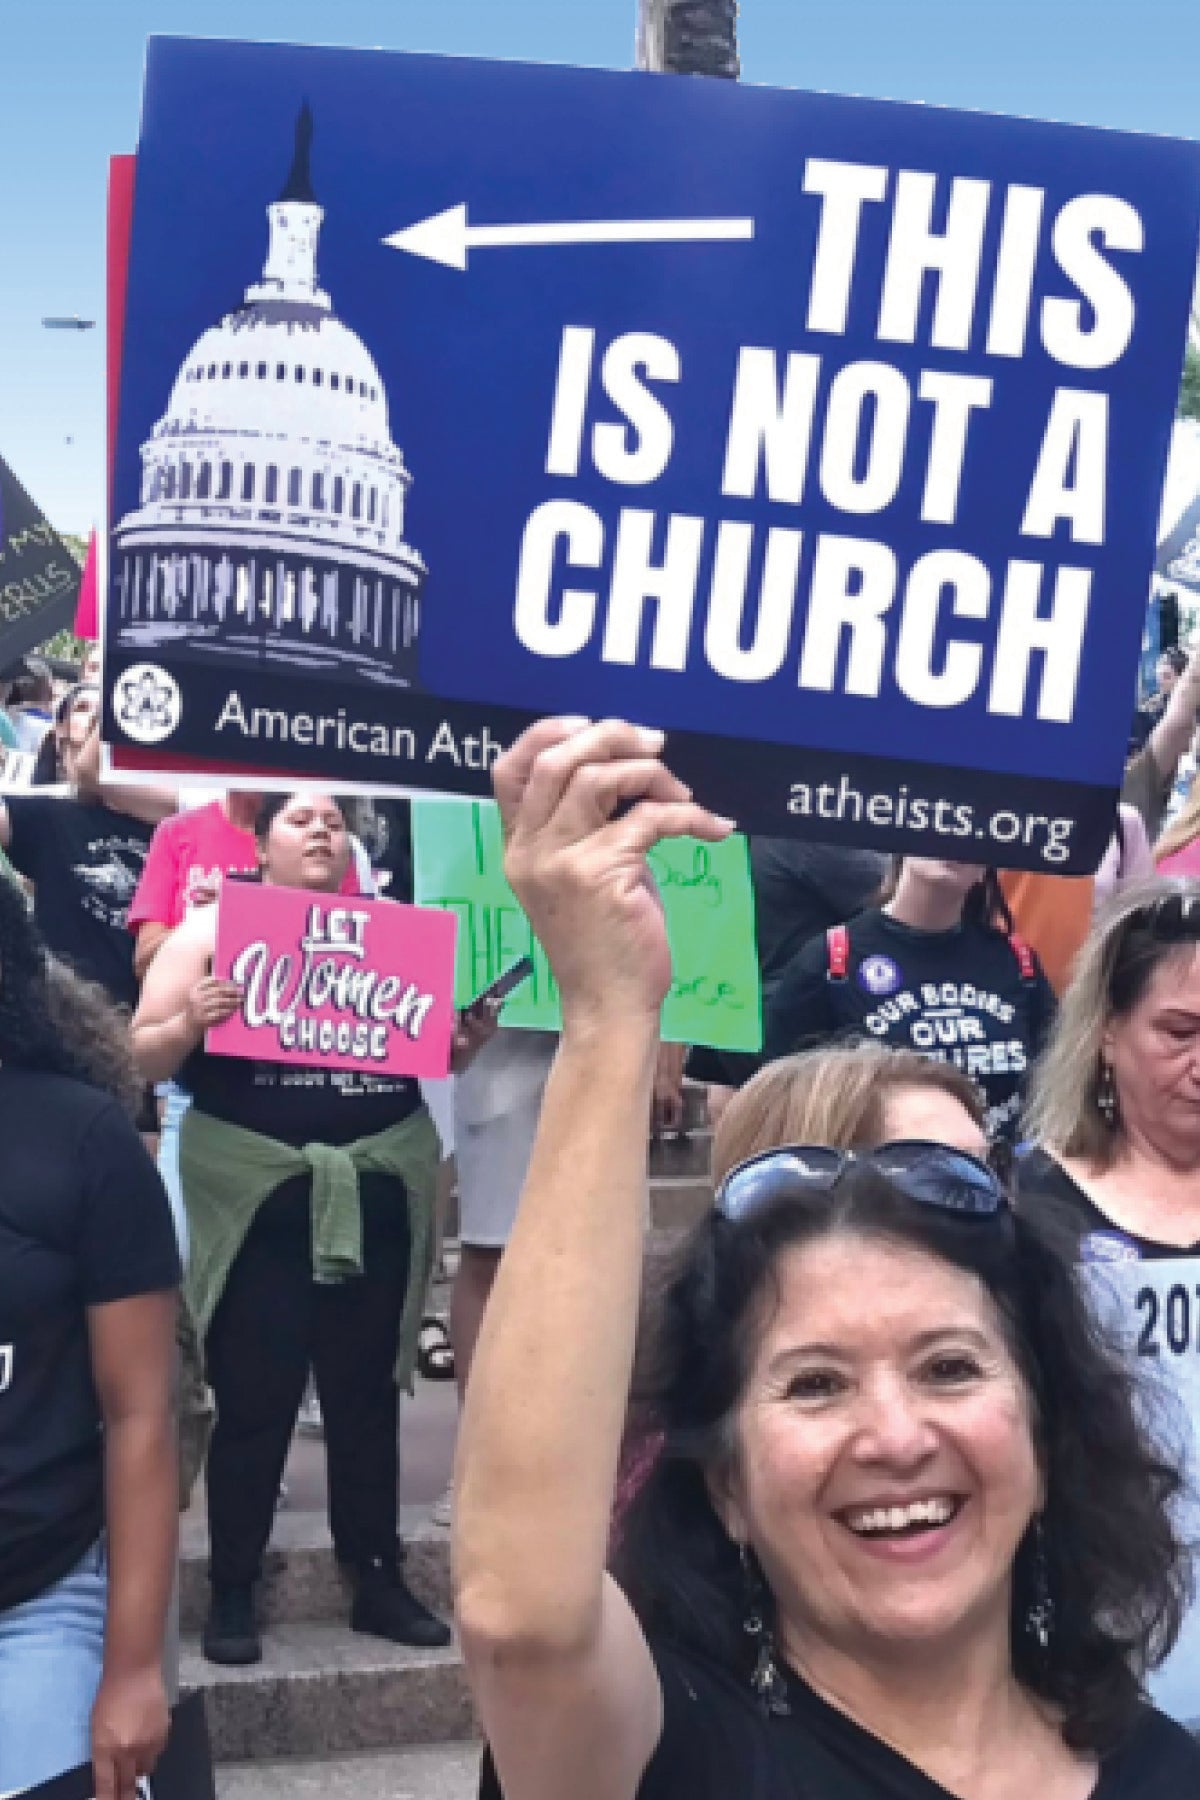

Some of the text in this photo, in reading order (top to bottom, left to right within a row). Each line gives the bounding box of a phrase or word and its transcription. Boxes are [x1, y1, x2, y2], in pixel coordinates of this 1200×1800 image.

[801, 157, 1146, 369] THIS
[544, 324, 1110, 546] IS NOT A
[513, 497, 1093, 724] CHURCH
[214, 689, 503, 771] American Ath
[786, 773, 1076, 862] atheists.org
[306, 904, 371, 943] LET
[229, 938, 435, 1041] Women
[864, 990, 921, 1035] OUR
[910, 1015, 986, 1046] OUR
[279, 1015, 389, 1062] CHOOSE
[1134, 1283, 1200, 1357] 20
